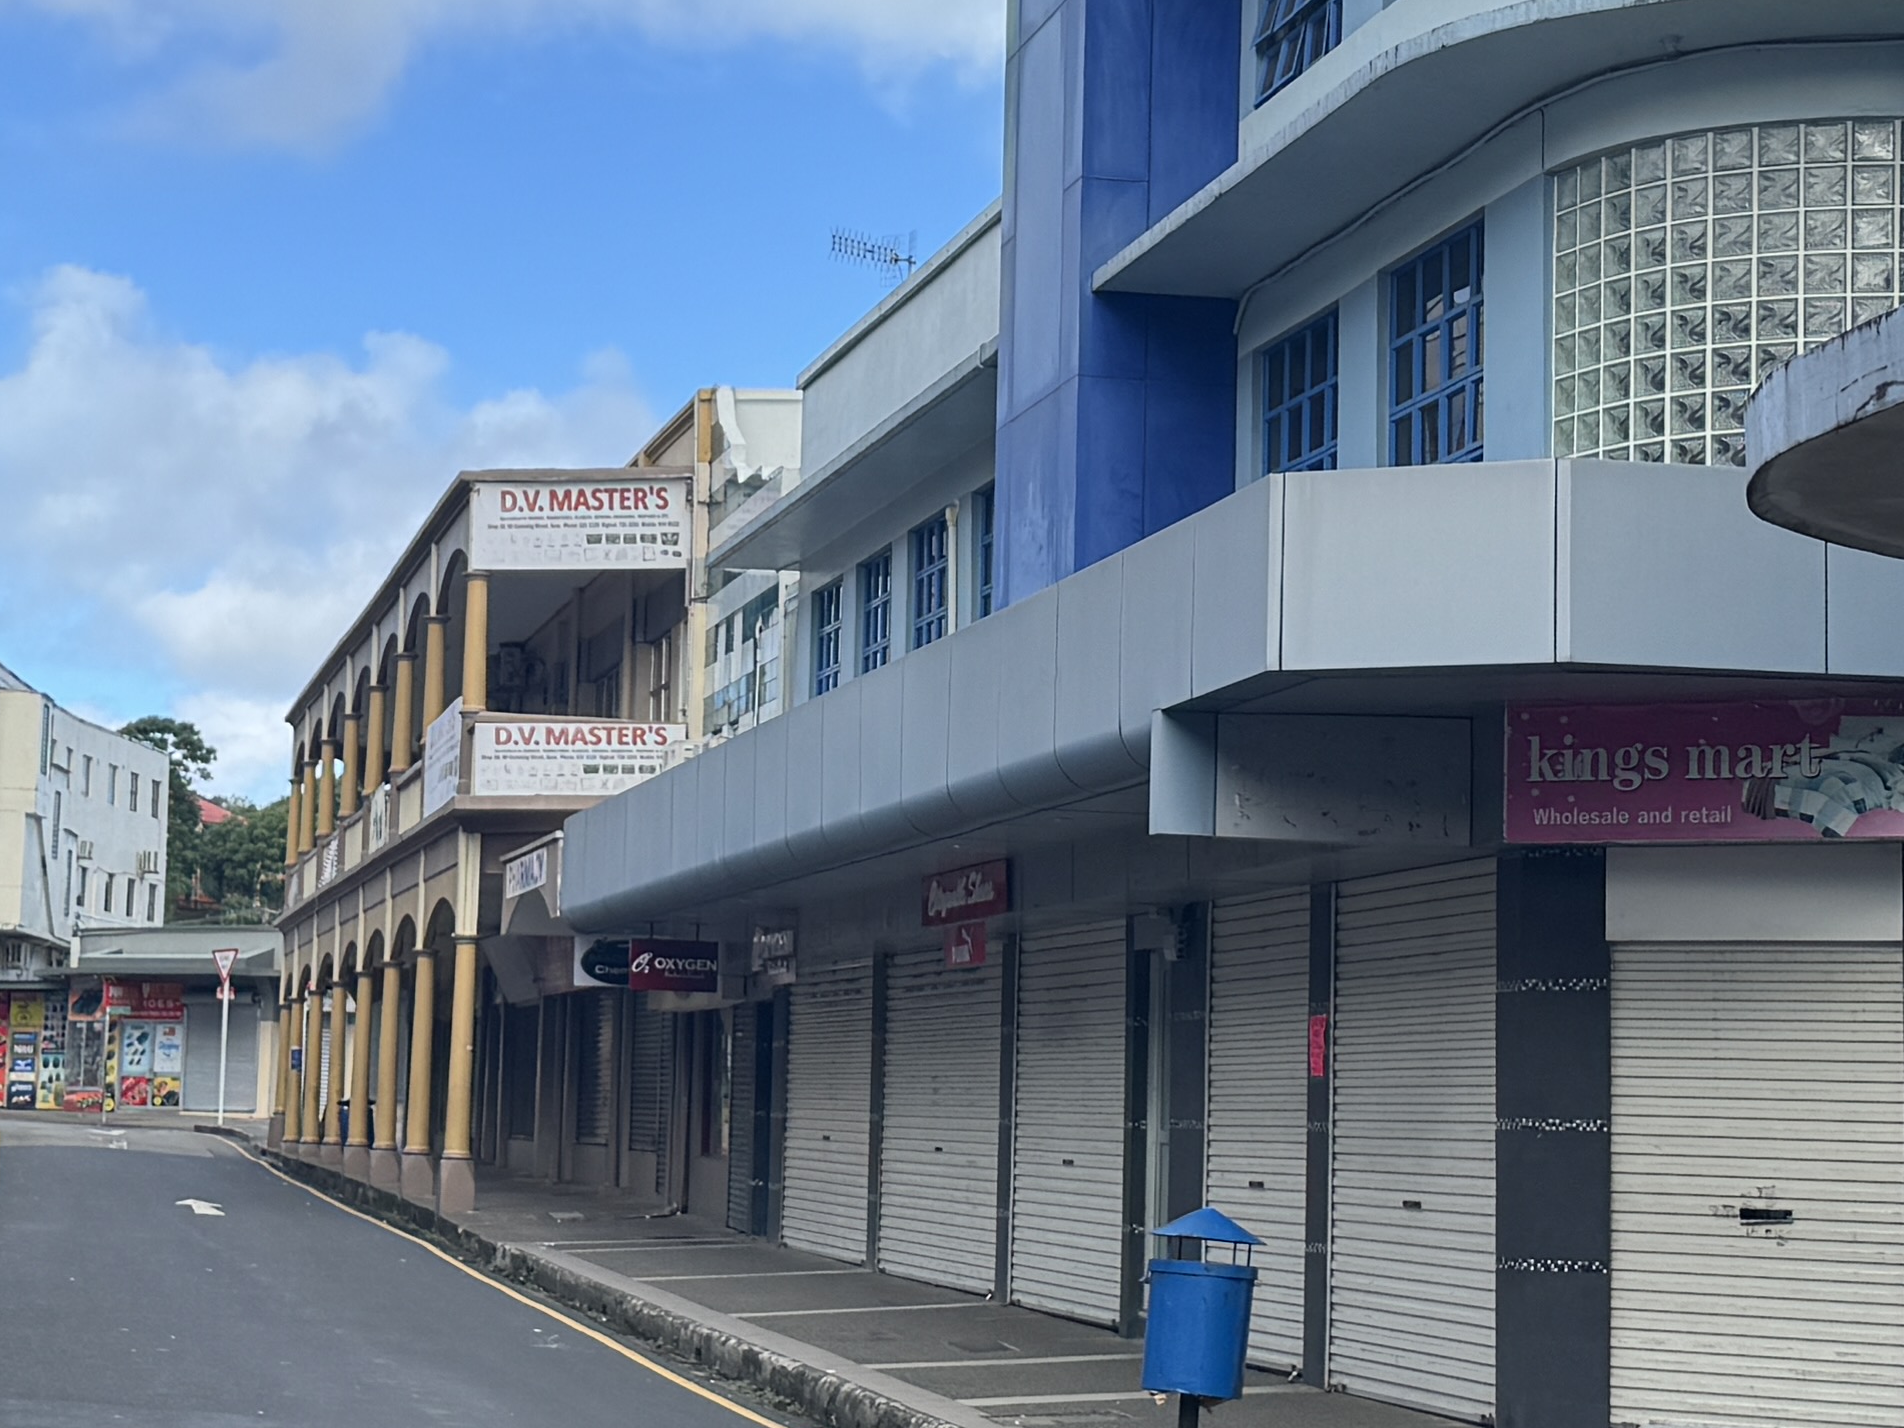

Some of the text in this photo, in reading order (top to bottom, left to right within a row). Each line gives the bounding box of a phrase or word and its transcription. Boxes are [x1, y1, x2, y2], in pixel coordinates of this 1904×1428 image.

[500, 485, 670, 513] D.V. MASTER'S
[495, 725, 668, 746] D.V. MASTER'S
[1525, 732, 1824, 792] kings mart
[1533, 804, 1732, 825] Wholesale and retail
[654, 956, 717, 972] OXYGEN
